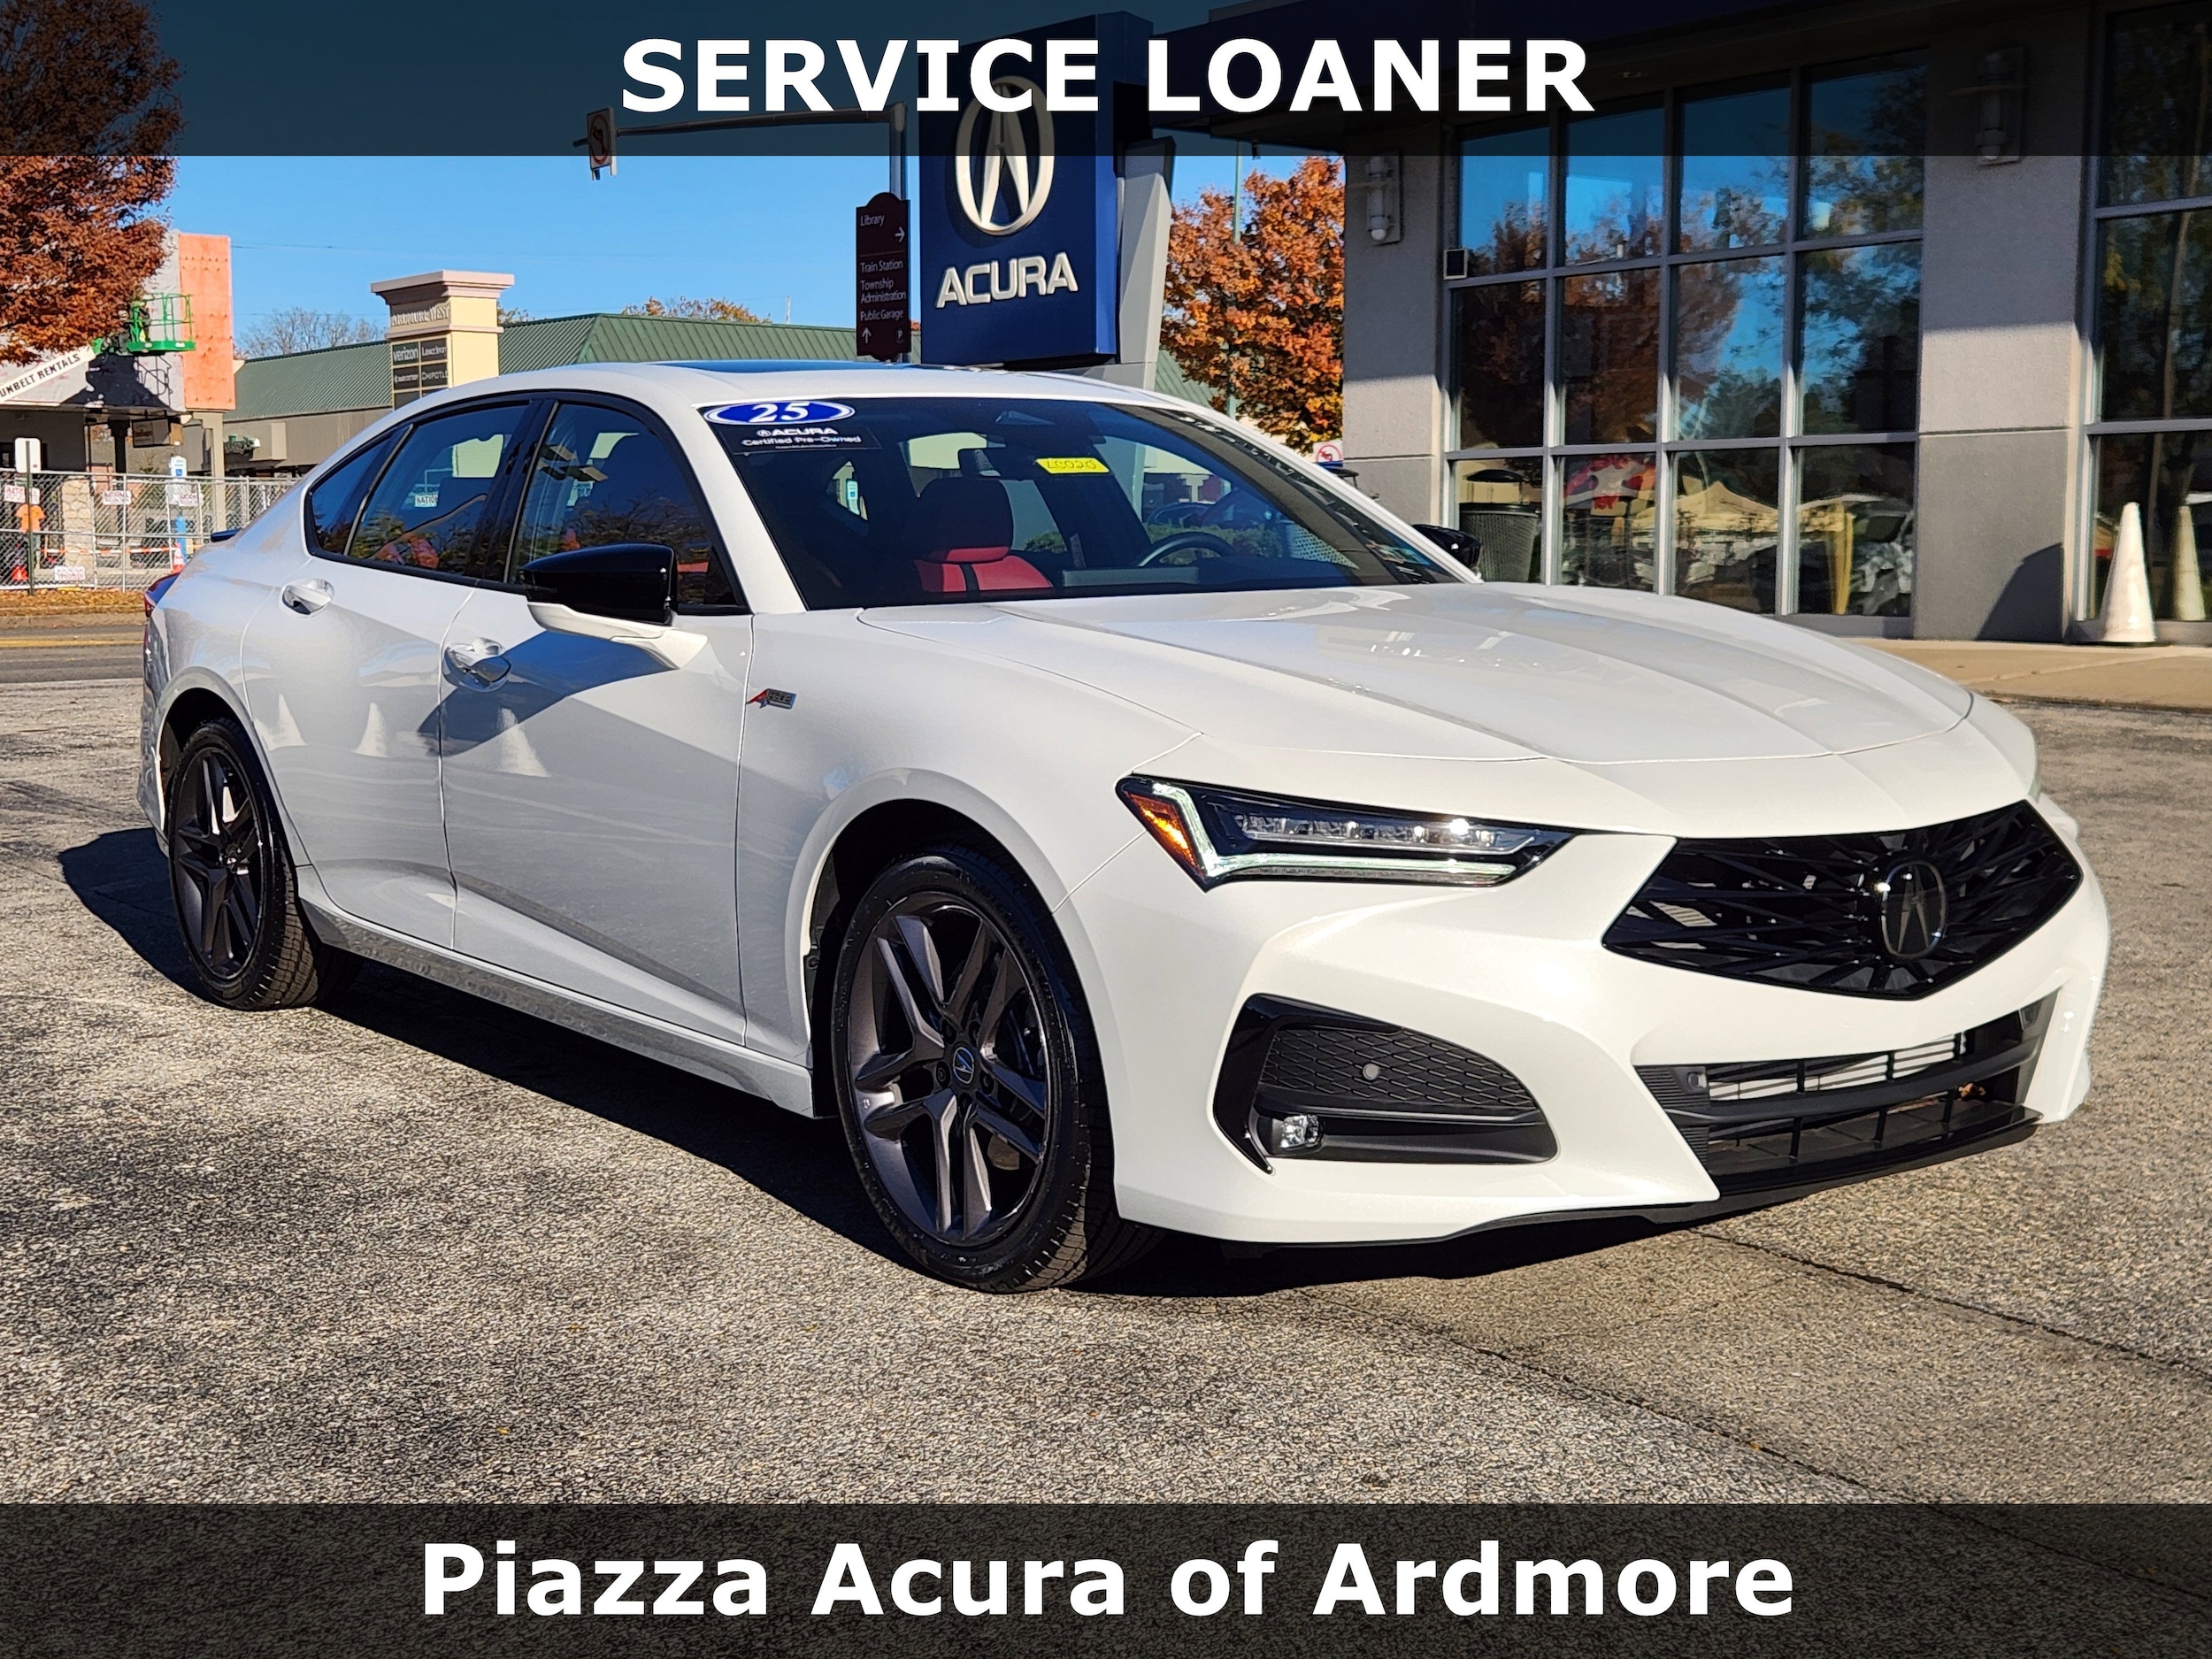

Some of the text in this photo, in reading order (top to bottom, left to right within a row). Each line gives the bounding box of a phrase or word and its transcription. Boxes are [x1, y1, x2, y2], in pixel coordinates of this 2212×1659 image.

[860, 214, 885, 227] Library
[860, 258, 903, 273] Train Station
[860, 277, 894, 291] Township
[936, 251, 1079, 309] ACURA
[861, 289, 907, 303] Administration
[860, 309, 903, 322] Public Garage
[393, 346, 419, 362] verizon
[37, 353, 81, 380] RENTALS
[749, 403, 810, 423] 25
[772, 426, 839, 436] ACURA
[741, 434, 863, 446] Certified Pre-Owned
